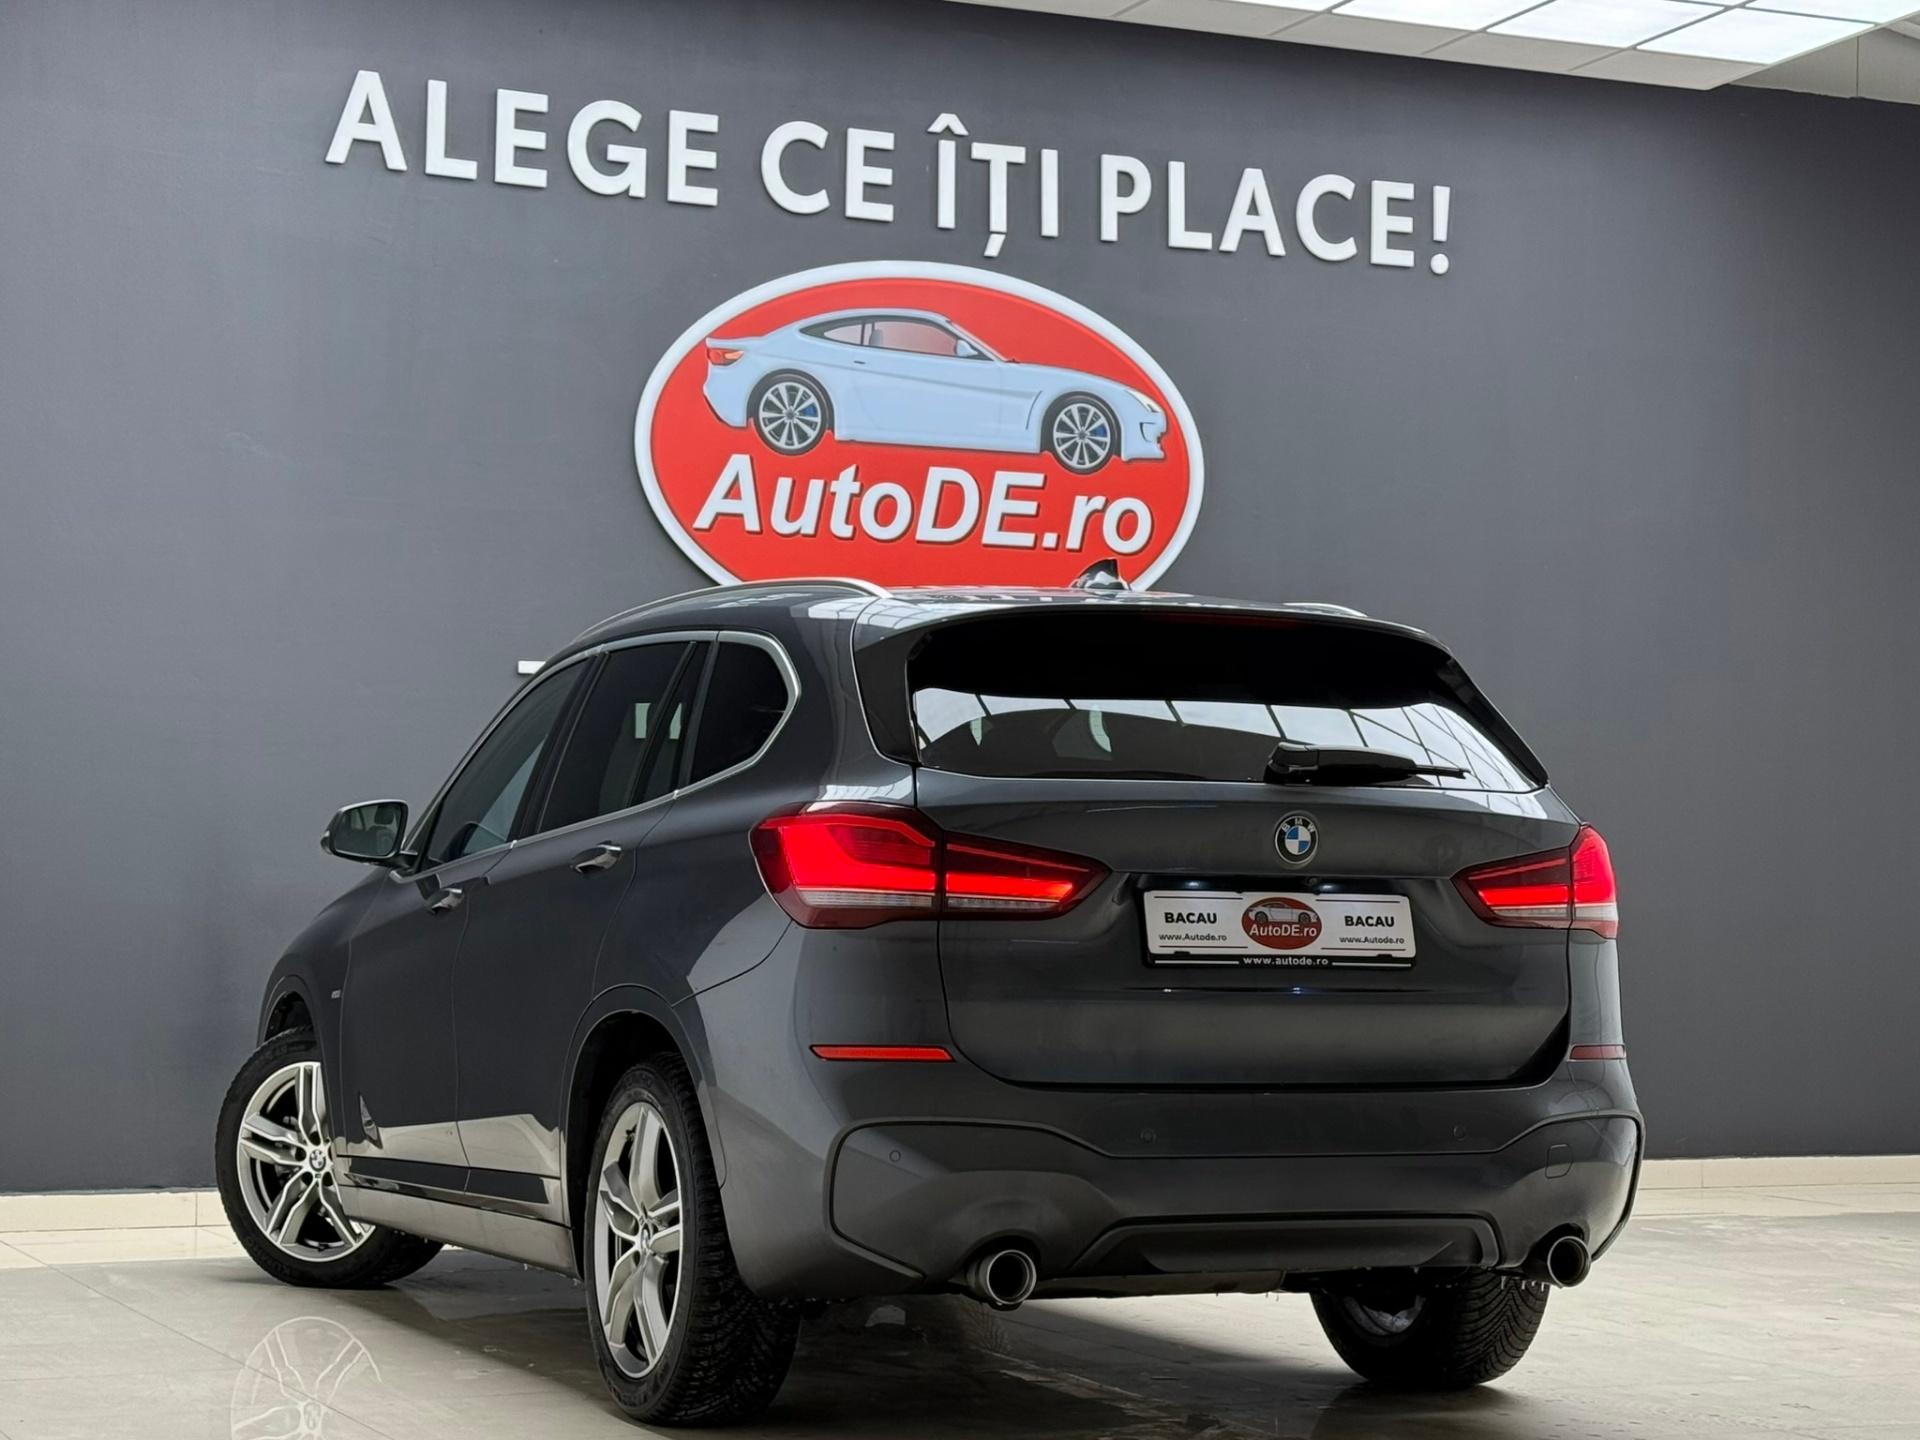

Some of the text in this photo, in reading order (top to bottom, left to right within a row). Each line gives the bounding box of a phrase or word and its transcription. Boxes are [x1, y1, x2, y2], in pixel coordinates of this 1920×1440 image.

[325, 69, 1450, 275] ALEGE CE ÎȚI PLACE!
[693, 453, 1152, 555] AutoDE.ro
[1164, 912, 1218, 924] BACAU
[1344, 915, 1395, 928] BACAU
[1249, 923, 1318, 938] AutoDE.ro
[1158, 932, 1228, 942] www.Autode.ro
[1339, 935, 1405, 945] www.Autode.ro
[1243, 956, 1329, 967] www.autode.ro
